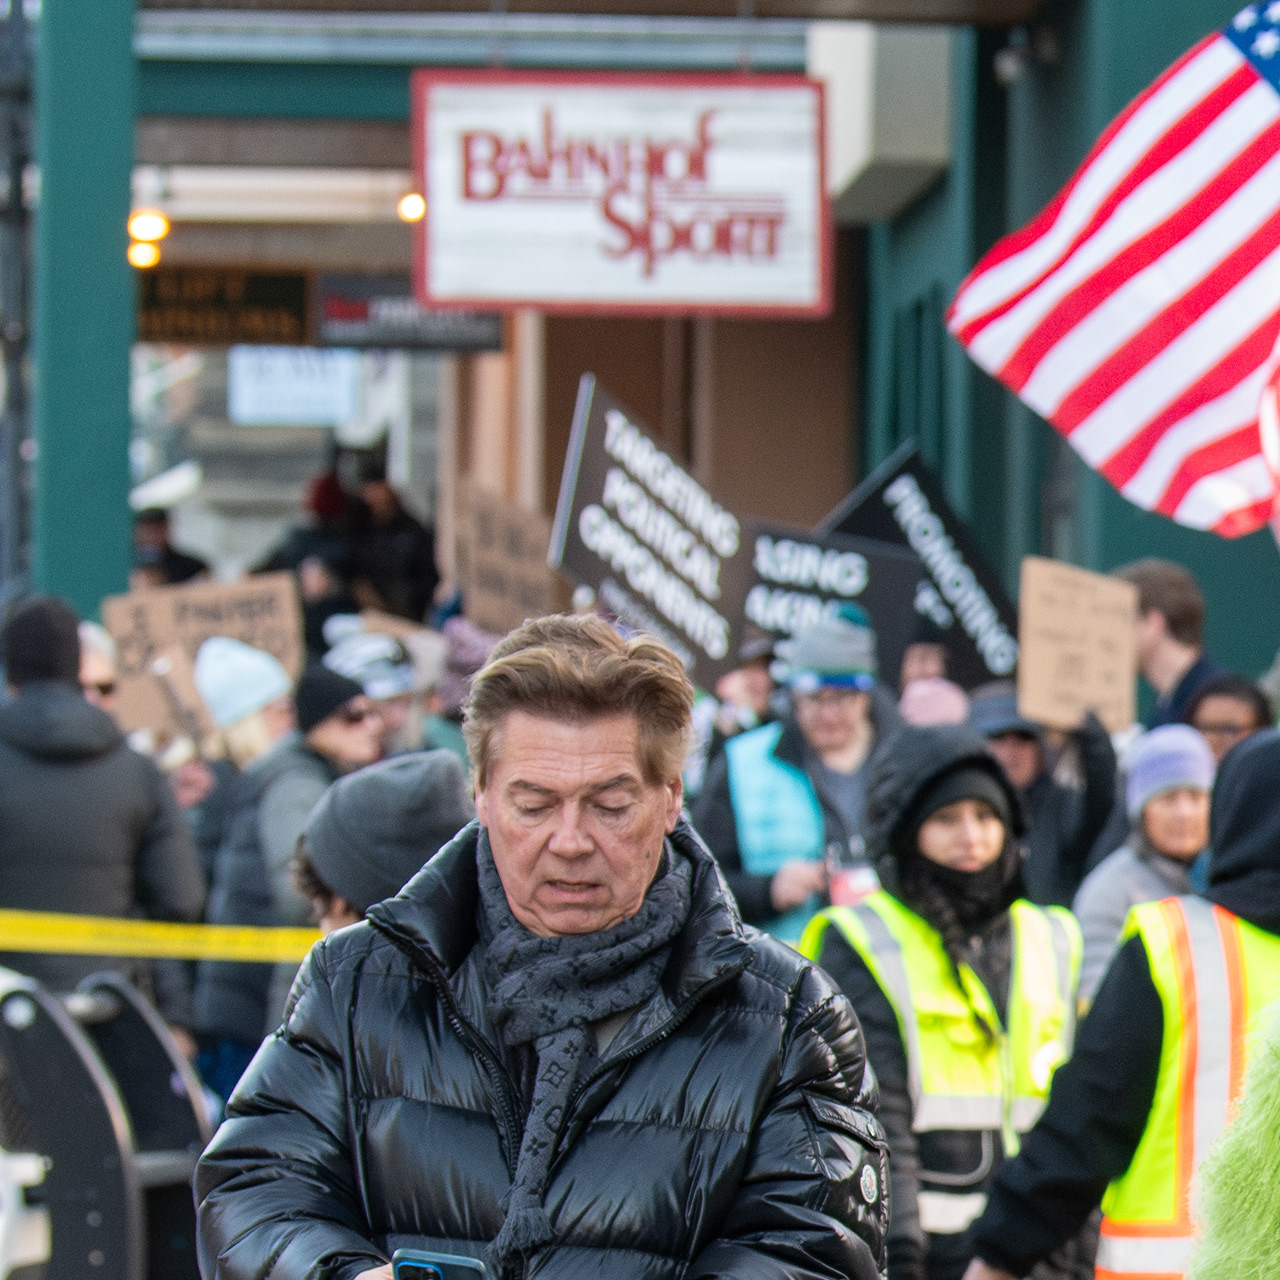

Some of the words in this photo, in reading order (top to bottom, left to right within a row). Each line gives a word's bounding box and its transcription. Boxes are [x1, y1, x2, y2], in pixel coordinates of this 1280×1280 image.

[601, 466, 721, 600] POLITICAL
[604, 408, 741, 558] TARGETING
[578, 503, 731, 661] OPPONENTS
[881, 473, 1020, 676] PROMOTING
